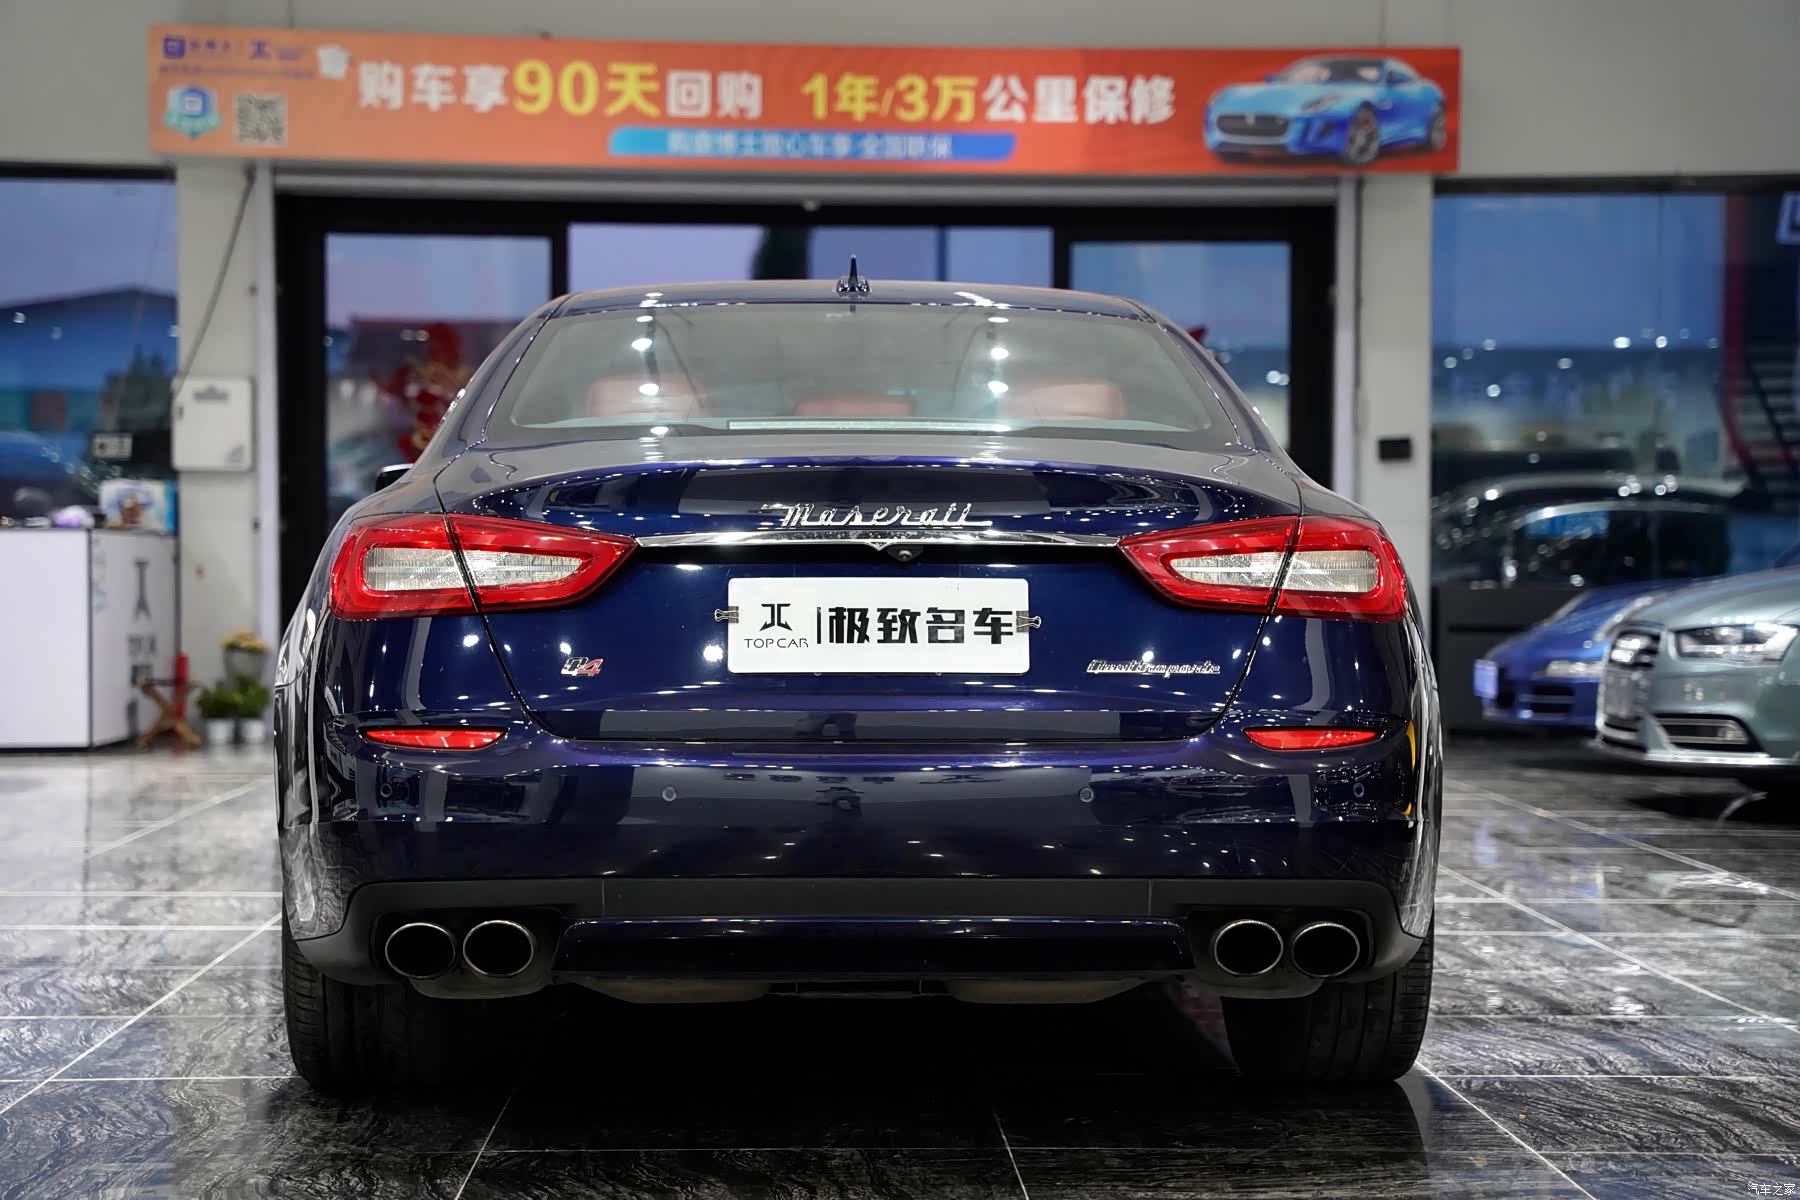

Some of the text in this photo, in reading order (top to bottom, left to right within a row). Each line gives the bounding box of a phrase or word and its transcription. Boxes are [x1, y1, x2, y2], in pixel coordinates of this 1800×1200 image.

[358, 58, 1176, 125] 购车享90天回购 1年/3万公里保修
[761, 502, 993, 527] Maserati
[828, 606, 1014, 645] 极致名车
[561, 656, 604, 677] Q4
